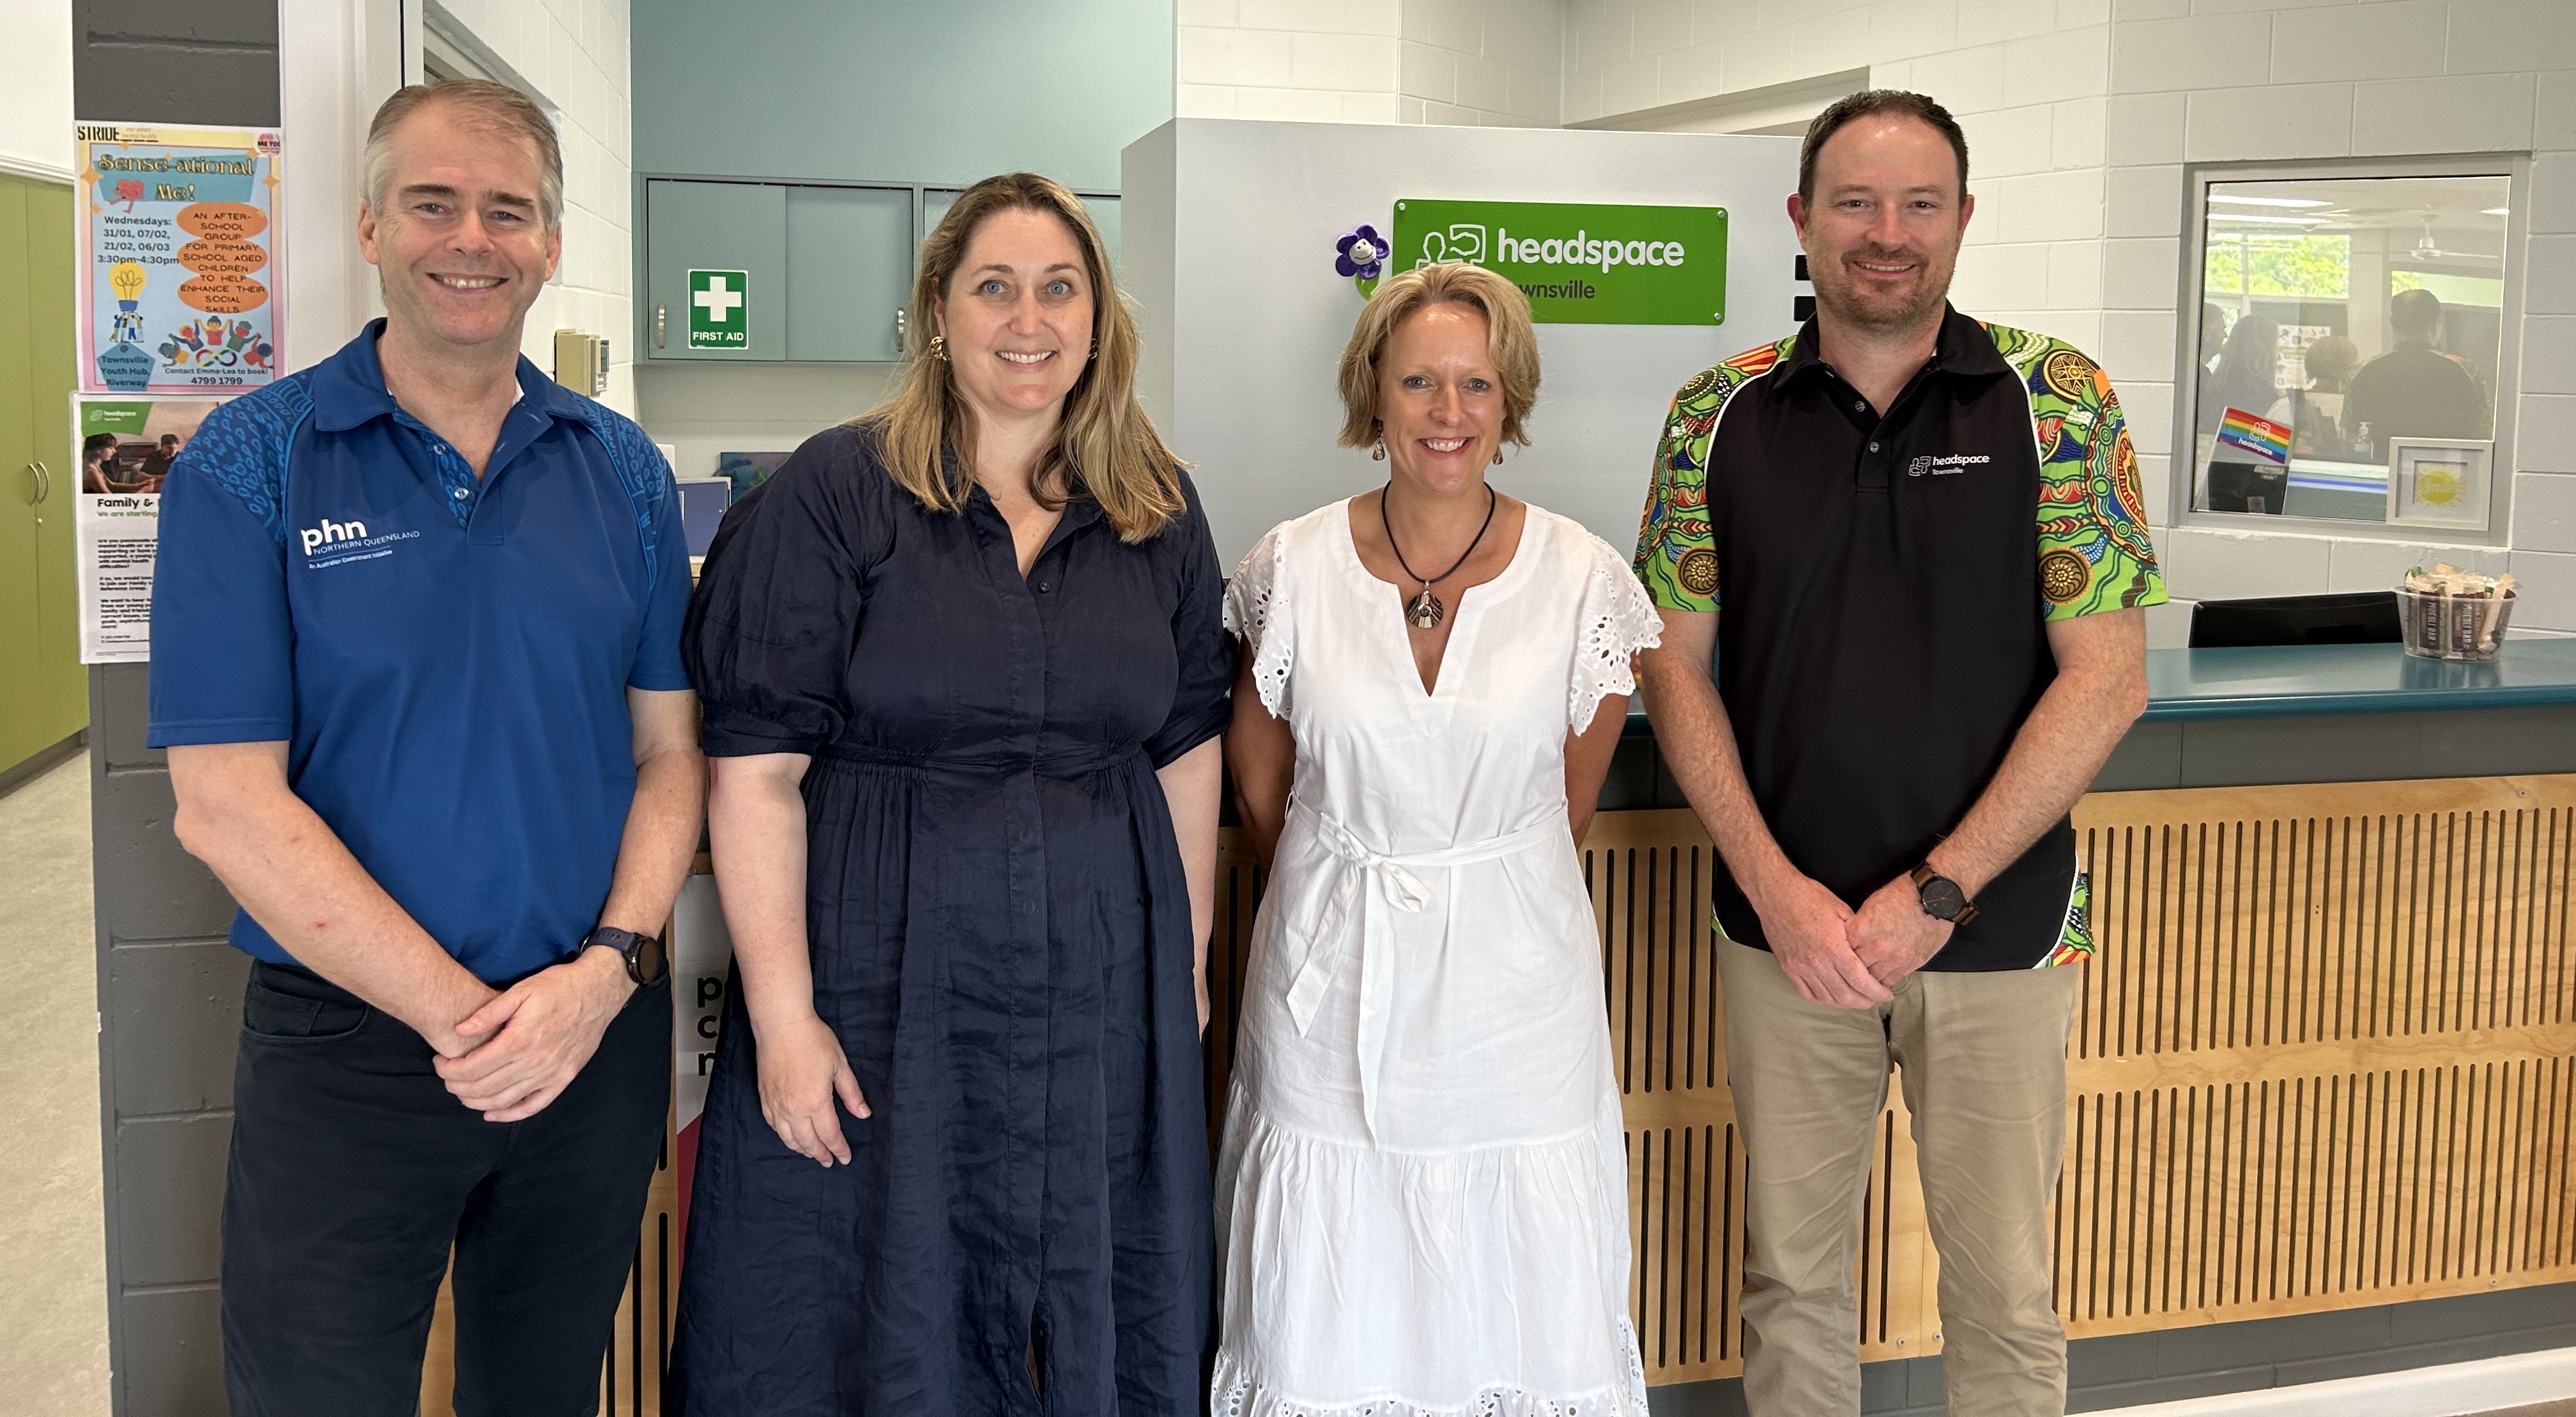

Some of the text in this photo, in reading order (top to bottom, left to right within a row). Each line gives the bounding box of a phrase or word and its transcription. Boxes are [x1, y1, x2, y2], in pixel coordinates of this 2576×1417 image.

[77, 126, 119, 141] STRIDE
[98, 153, 254, 176] Sense-ational
[155, 183, 195, 201] Me!
[104, 216, 172, 227] Wednesdays:
[103, 228, 170, 240] 31/01, 07/02,
[204, 233, 241, 241] GROUP
[104, 241, 171, 252] 21/02, 06/03
[1497, 227, 1685, 274] headspace
[97, 254, 180, 266] 3:30pm-4:30pm
[183, 253, 227, 261] SCHOOL
[180, 284, 229, 293] ENHANCE
[1519, 280, 1595, 299] wnsville
[693, 332, 744, 341] FIRST AID
[130, 367, 150, 376] Hub,
[2238, 437, 2273, 456] headspace
[1933, 454, 1989, 466] headspace
[1932, 467, 1964, 475] Townsville
[97, 497, 153, 510] Family &
[300, 518, 367, 556] phn
[313, 530, 420, 555] NORTHERN QUEENSLAND
[2428, 602, 2437, 641] MUESLI BAR
[2462, 604, 2472, 643] MUESLI BAR
